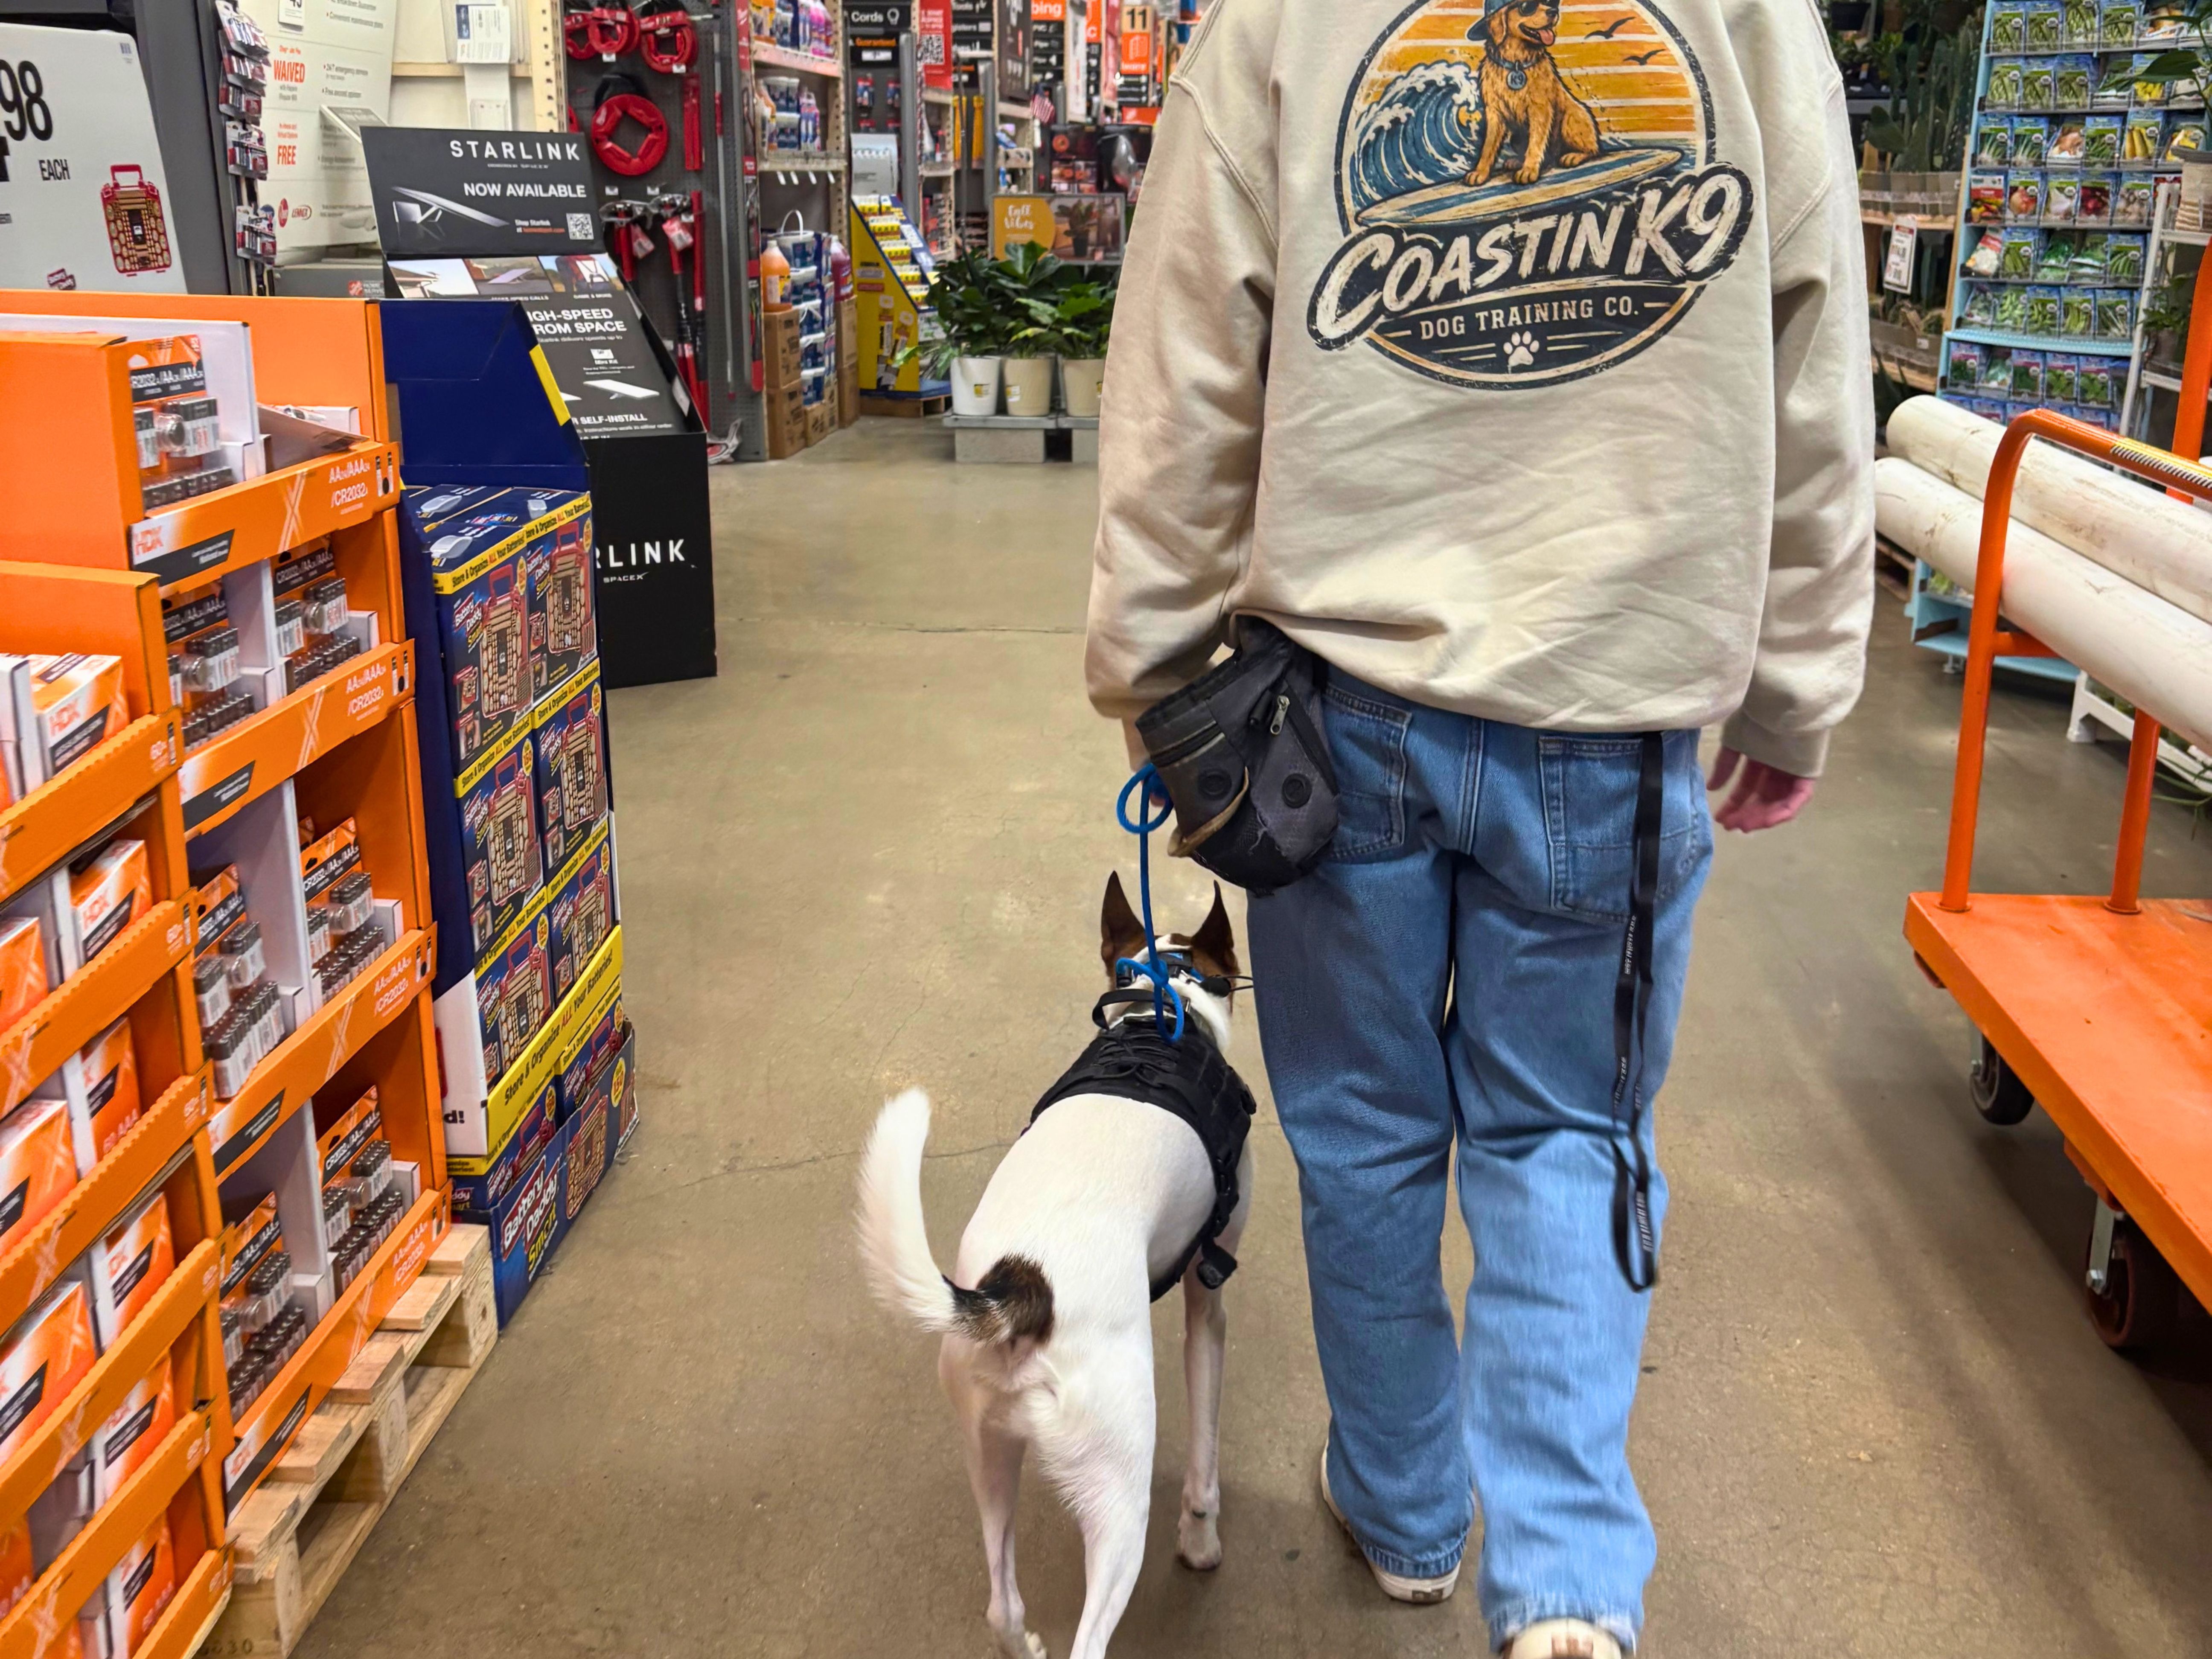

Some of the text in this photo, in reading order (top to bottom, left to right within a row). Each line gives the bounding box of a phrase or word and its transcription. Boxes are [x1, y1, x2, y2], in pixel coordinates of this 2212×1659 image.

[851, 11, 883, 23] Cords
[1127, 8, 1147, 29] 11
[274, 60, 305, 83] WAIVED
[277, 145, 296, 165] FREE
[450, 140, 580, 160] STARLINK
[38, 159, 70, 181] EACH
[463, 182, 587, 198] NOW AVAILABLE
[1316, 201, 1625, 338] COASTIN
[1624, 173, 1743, 277] K9
[527, 308, 613, 322] IGH-SPEED
[1420, 296, 1639, 340] DOG TRAINING CO.
[533, 321, 627, 335] ROM SPACE
[580, 413, 648, 424] SELF-INSTALL
[526, 528, 534, 538] tore
[596, 539, 685, 569] RLINK
[603, 571, 648, 583] SPACEX
[455, 599, 474, 627] Battery
[466, 608, 482, 632] Daddy
[505, 1074, 524, 1106] Store
[531, 1024, 560, 1069] Organize
[560, 1005, 573, 1030] ALL
[573, 987, 587, 1013] Your
[587, 948, 613, 995] Batteries!
[505, 1171, 544, 1250] Battery
[526, 1174, 558, 1241] Daddy
[528, 1201, 556, 1272] Smart
